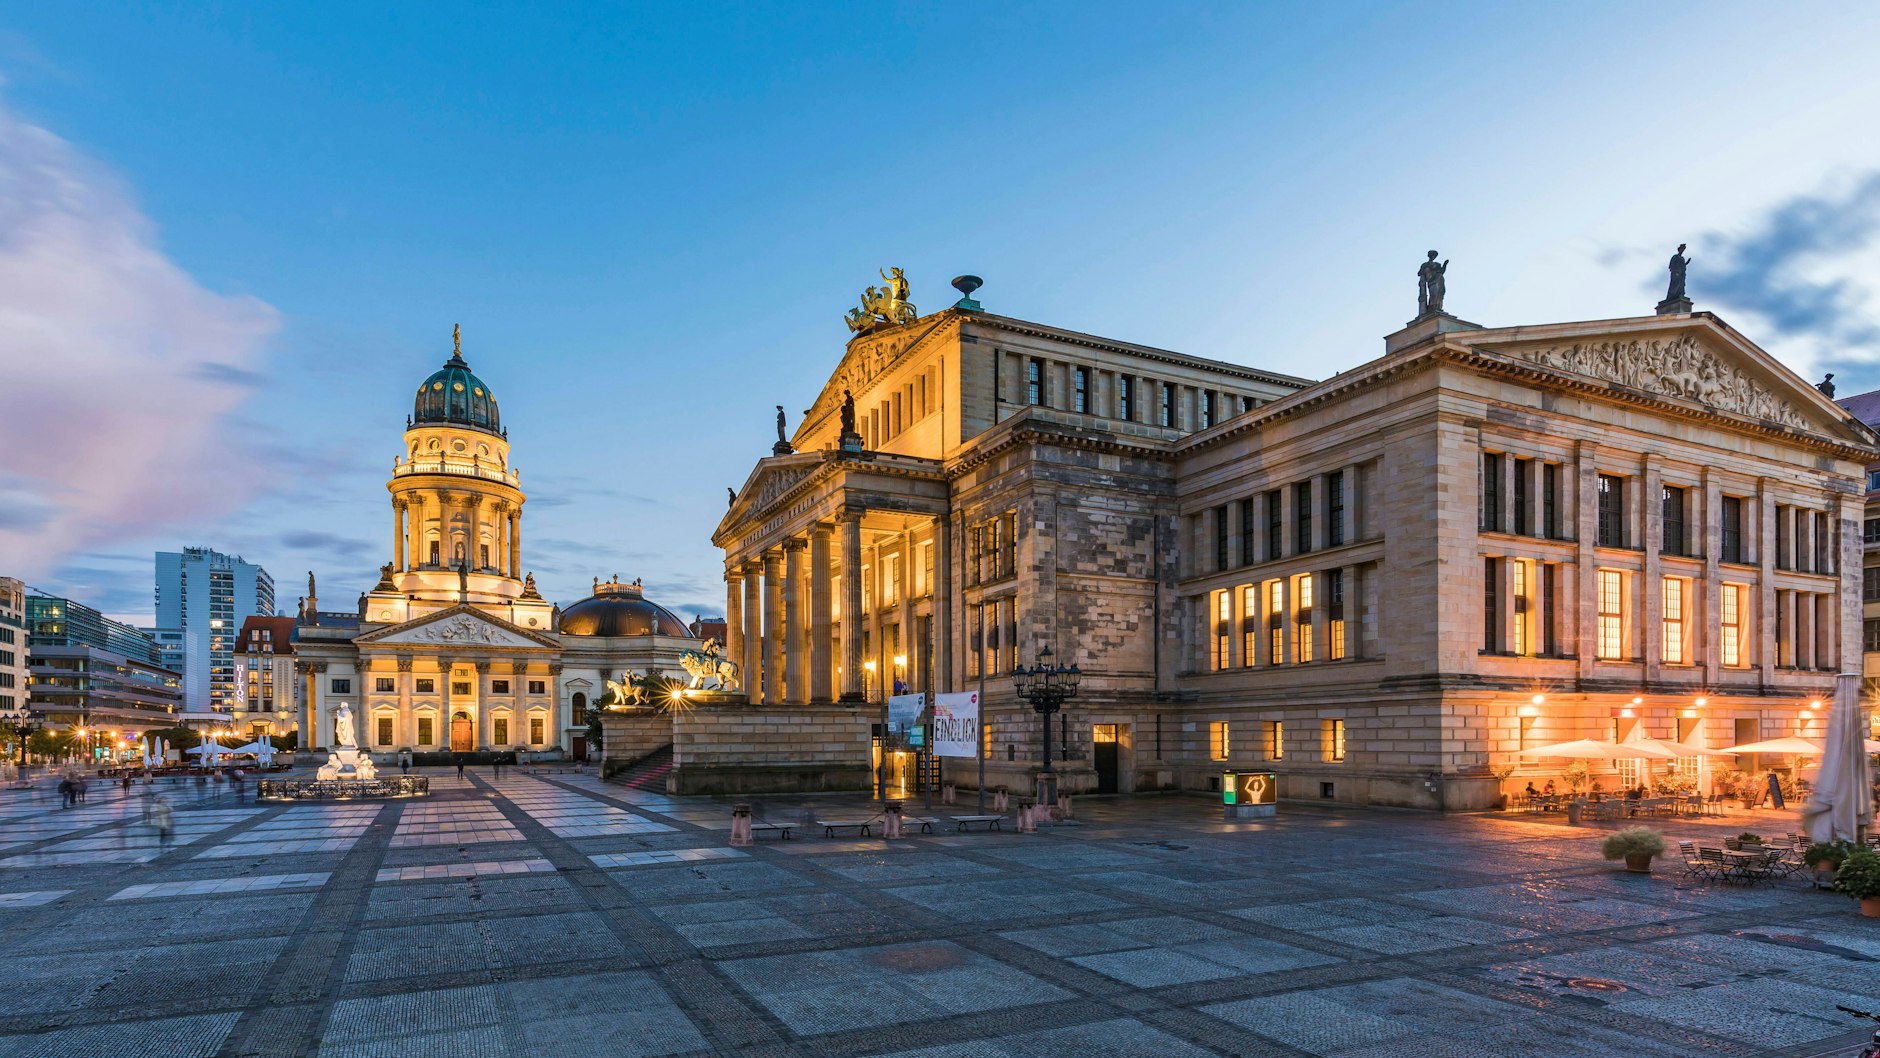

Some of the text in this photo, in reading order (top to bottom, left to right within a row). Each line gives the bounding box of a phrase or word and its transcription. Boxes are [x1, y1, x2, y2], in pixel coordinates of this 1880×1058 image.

[743, 495, 815, 547] KONZERTHAUS BERLIN
[236, 664, 244, 702] HILTON
[935, 718, 977, 742] EINBLICK
